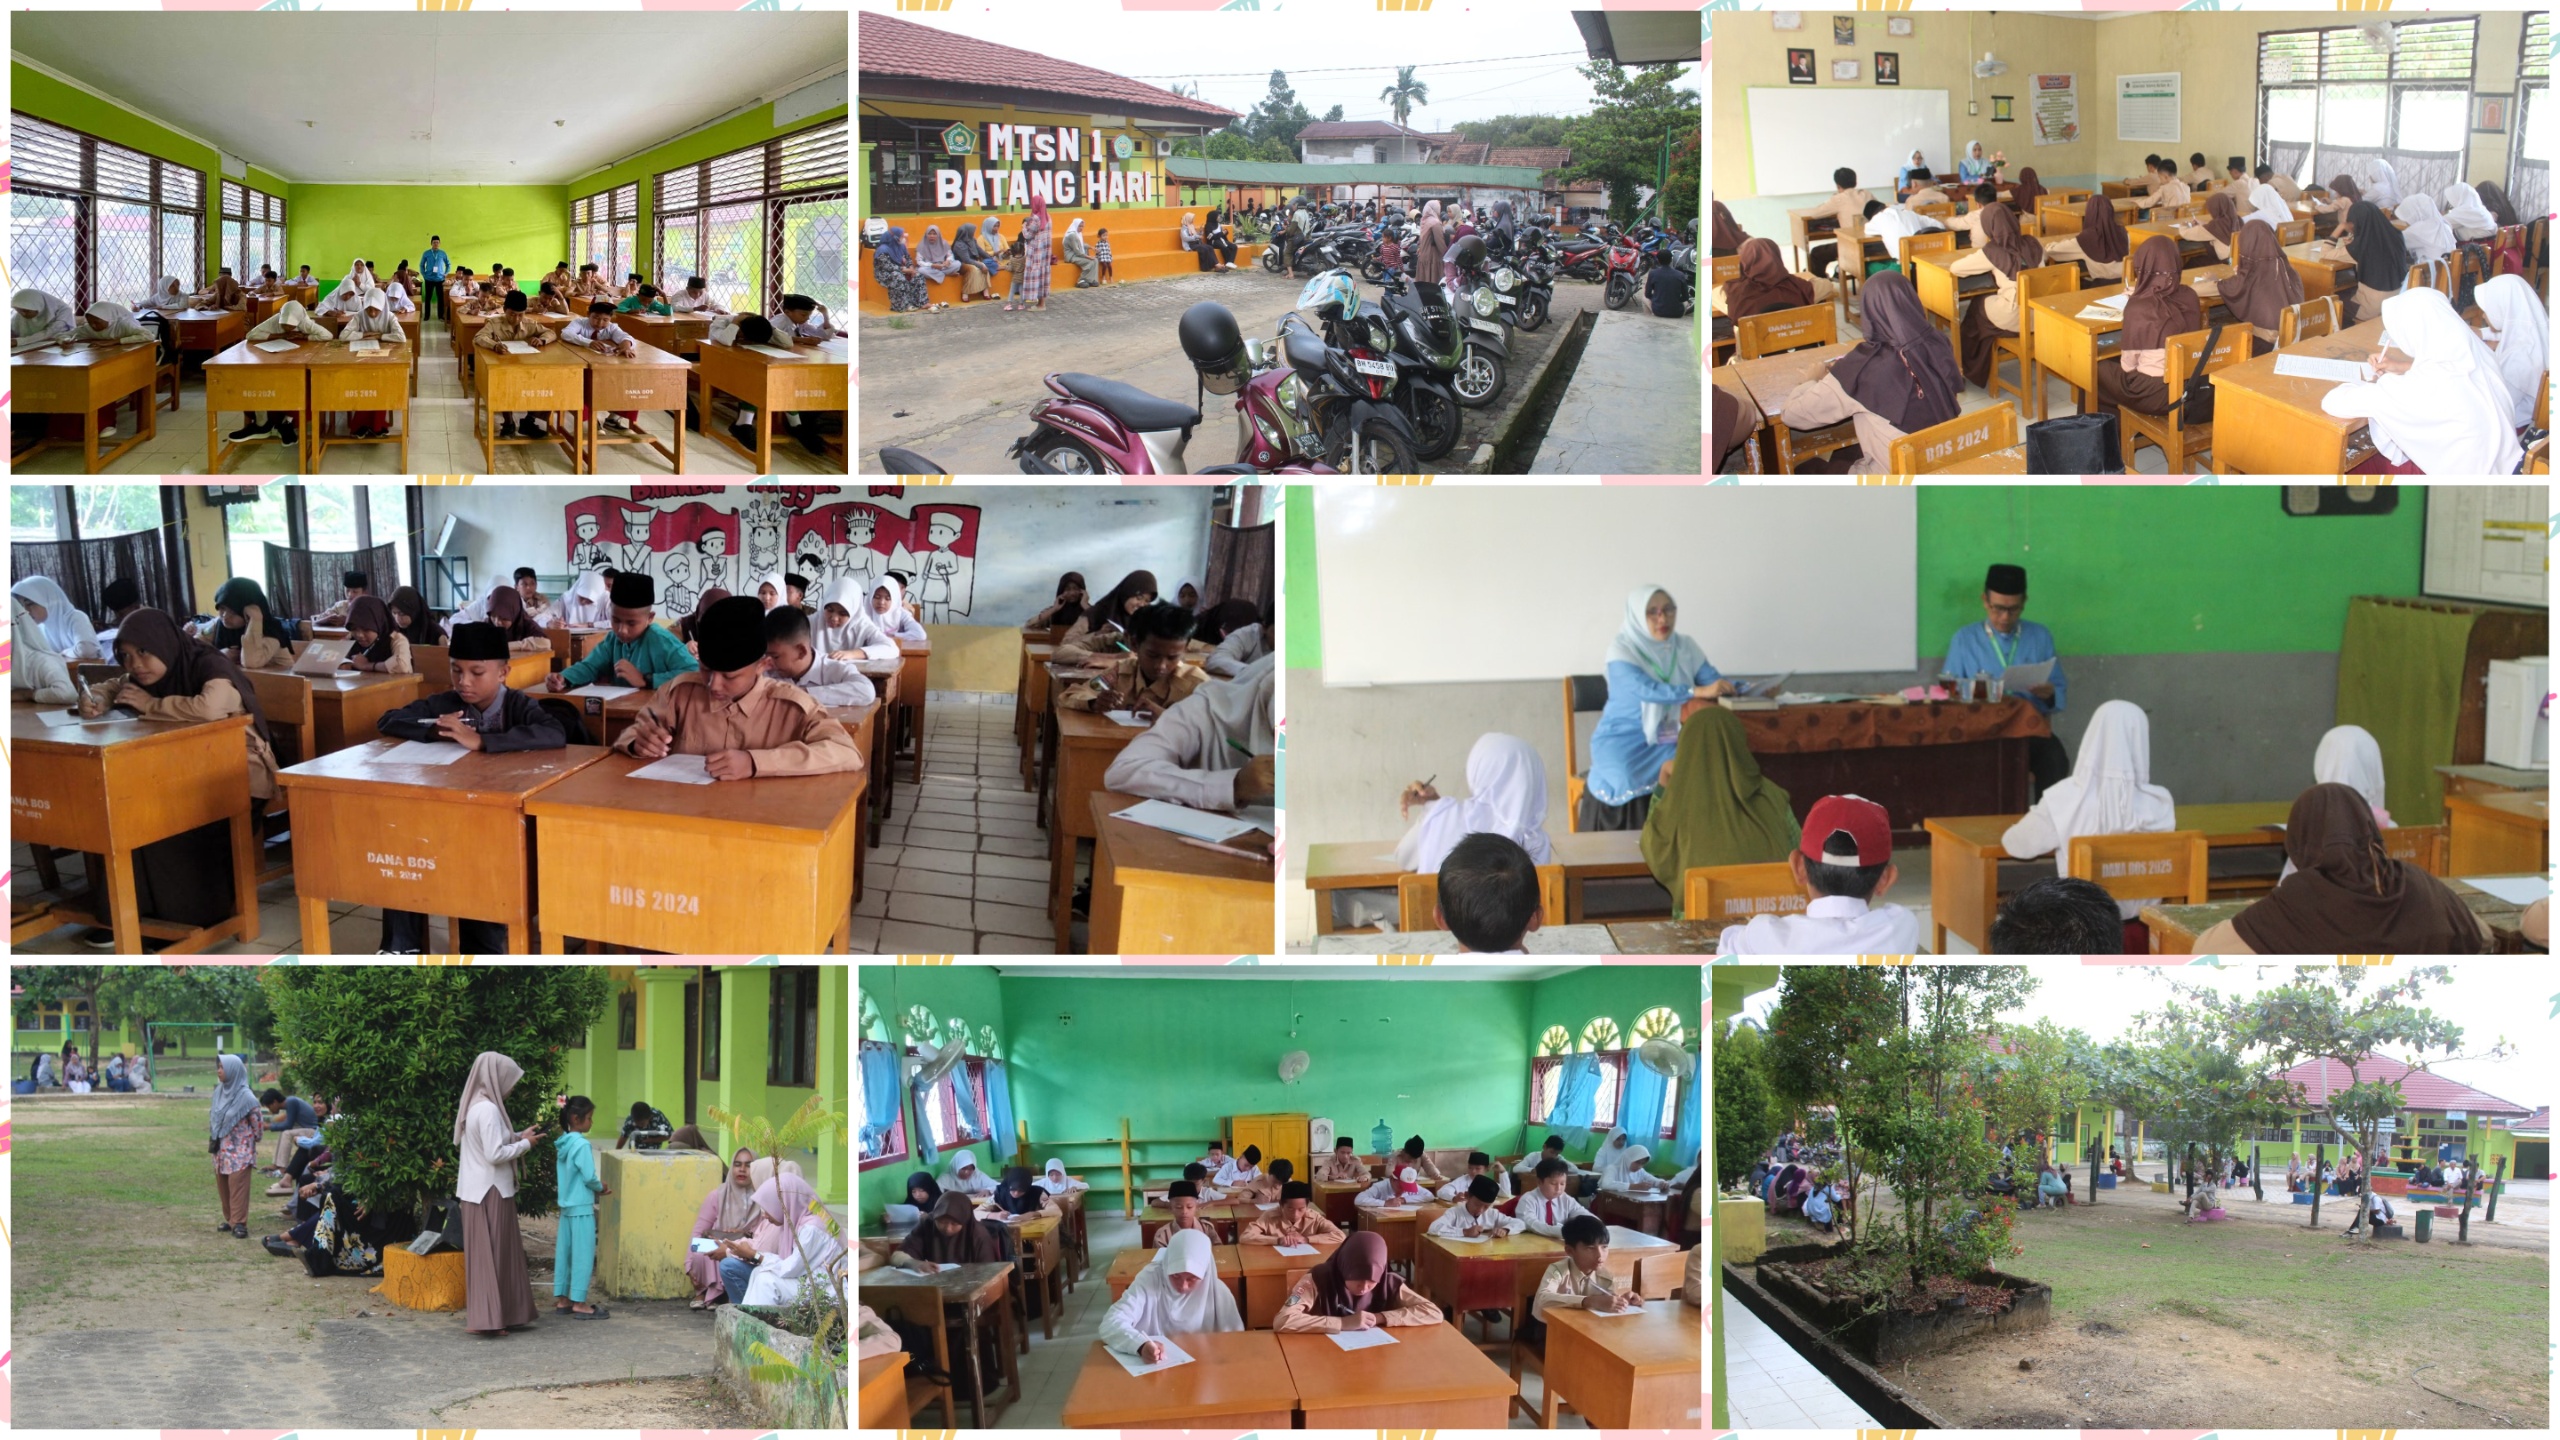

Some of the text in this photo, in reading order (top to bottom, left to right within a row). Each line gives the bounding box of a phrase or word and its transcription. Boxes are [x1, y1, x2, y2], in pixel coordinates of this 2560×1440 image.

[988, 123, 1103, 162] MTsN 1
[935, 169, 1152, 207] BATANG HARI
[1767, 323, 1793, 333] DANA
[2215, 346, 2232, 355] BOS
[1926, 425, 1989, 463] BOS 2024
[11, 796, 51, 810] ANA BOS
[367, 851, 436, 870] DANA BOS
[399, 870, 423, 880] 2021
[609, 884, 699, 916] BOS 2024
[1725, 894, 1807, 914] DANA BOS 2025
